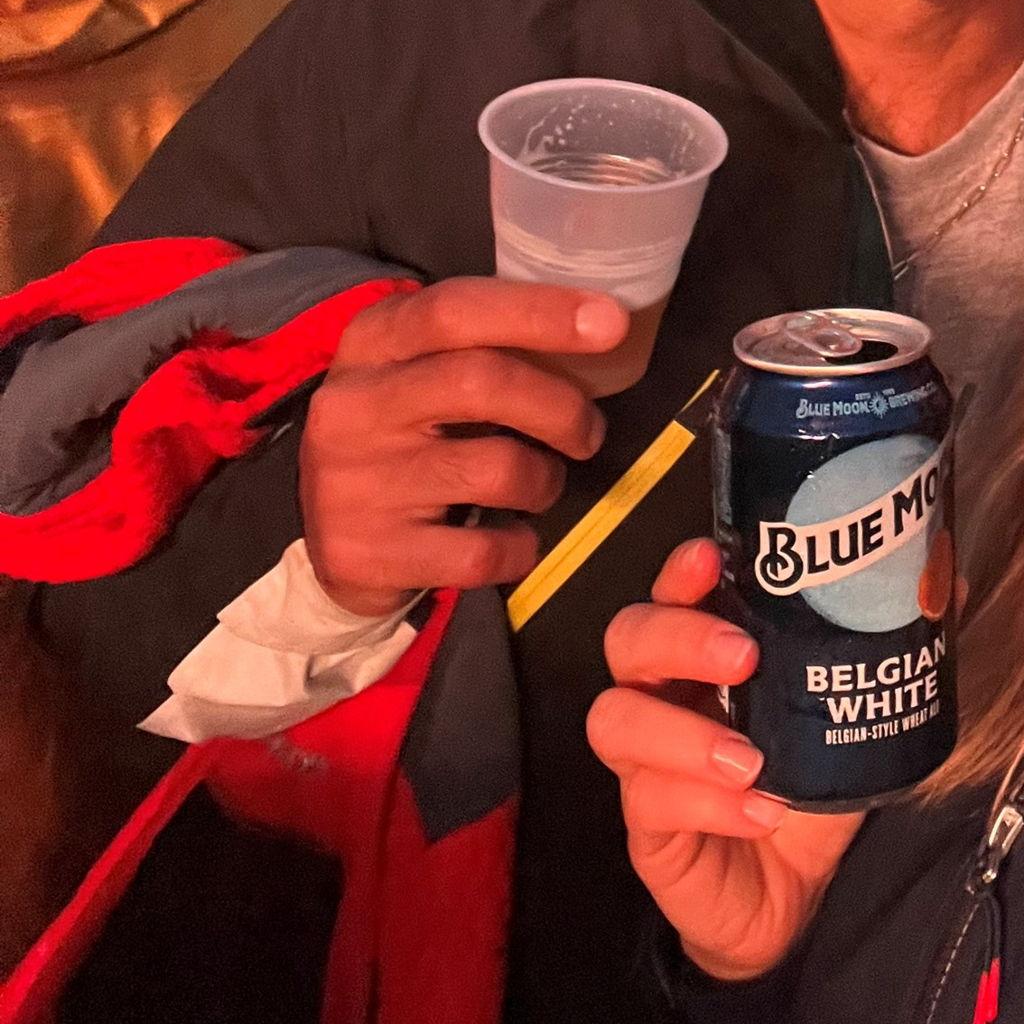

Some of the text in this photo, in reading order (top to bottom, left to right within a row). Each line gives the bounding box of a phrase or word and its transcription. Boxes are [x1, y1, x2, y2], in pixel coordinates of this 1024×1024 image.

[796, 398, 830, 419] BLUE
[833, 400, 870, 416] MOON
[760, 467, 938, 588] BLUE MO
[806, 630, 946, 693] BELGIAN
[826, 670, 938, 724] WHITE
[825, 720, 898, 745] BELGIAN-STYLE
[902, 707, 928, 732] WHEAT
